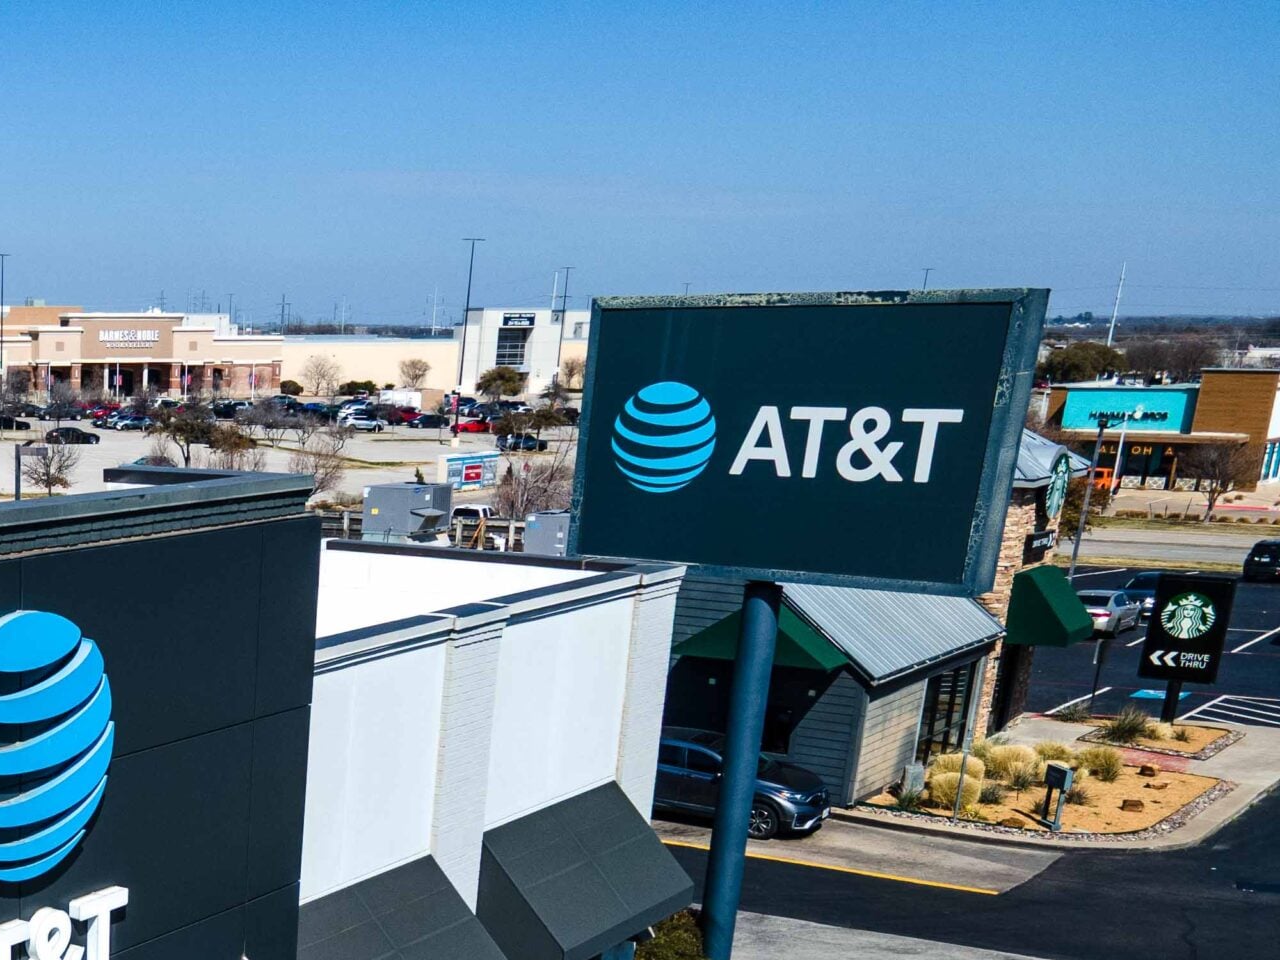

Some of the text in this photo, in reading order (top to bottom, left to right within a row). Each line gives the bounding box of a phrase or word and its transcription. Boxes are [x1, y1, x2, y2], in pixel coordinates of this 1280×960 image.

[728, 405, 965, 484] AT&T
[1180, 652, 1210, 662] DRIVE
[1180, 660, 1207, 669] THRU
